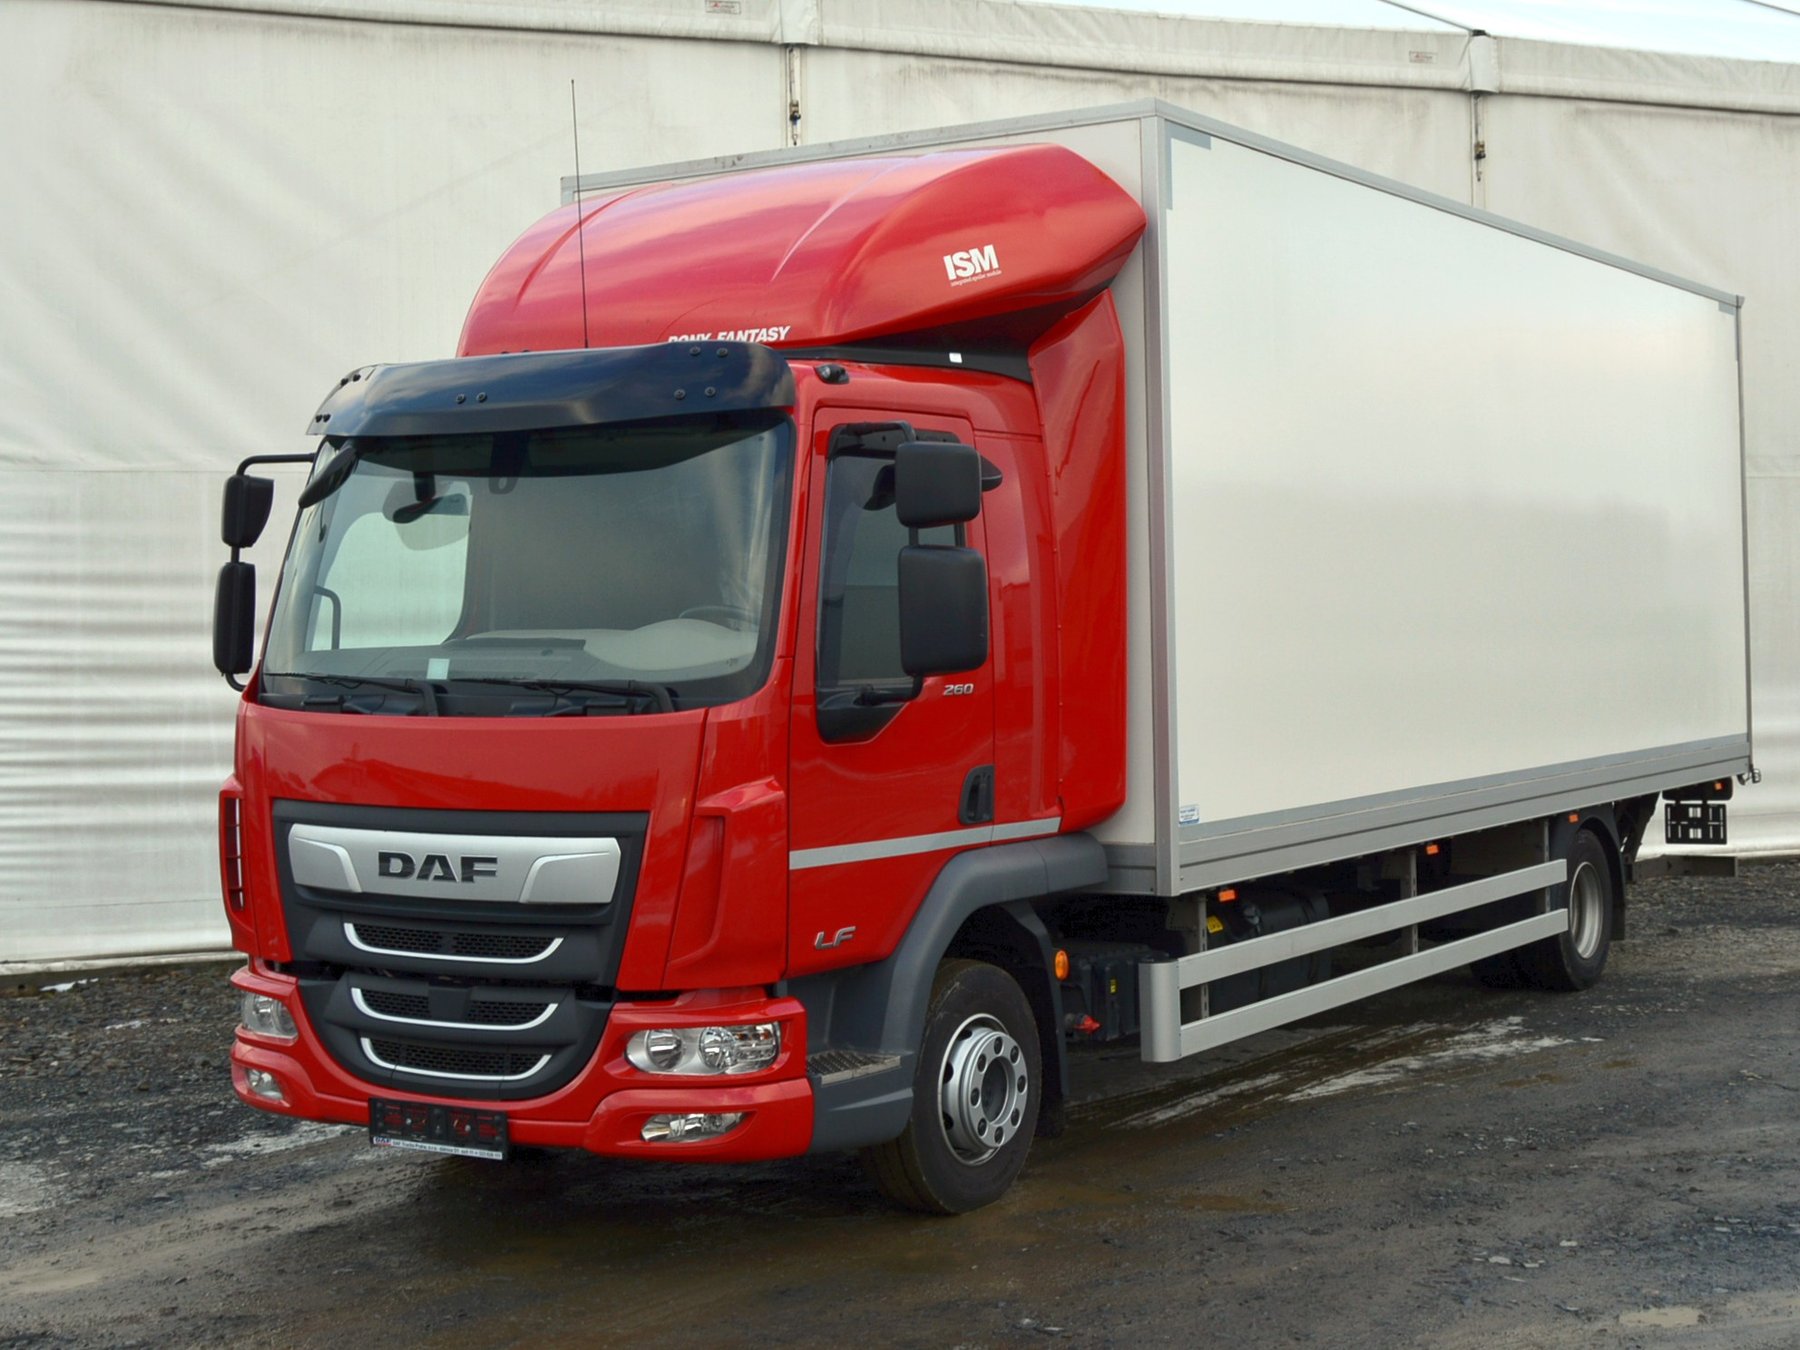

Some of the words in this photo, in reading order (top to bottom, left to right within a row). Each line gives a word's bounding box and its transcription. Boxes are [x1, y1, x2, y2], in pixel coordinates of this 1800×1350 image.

[943, 244, 1000, 281] ISM
[717, 325, 791, 342] FANTASY
[943, 683, 974, 696] 260
[378, 850, 498, 883] DAF
[814, 926, 856, 950] LF
